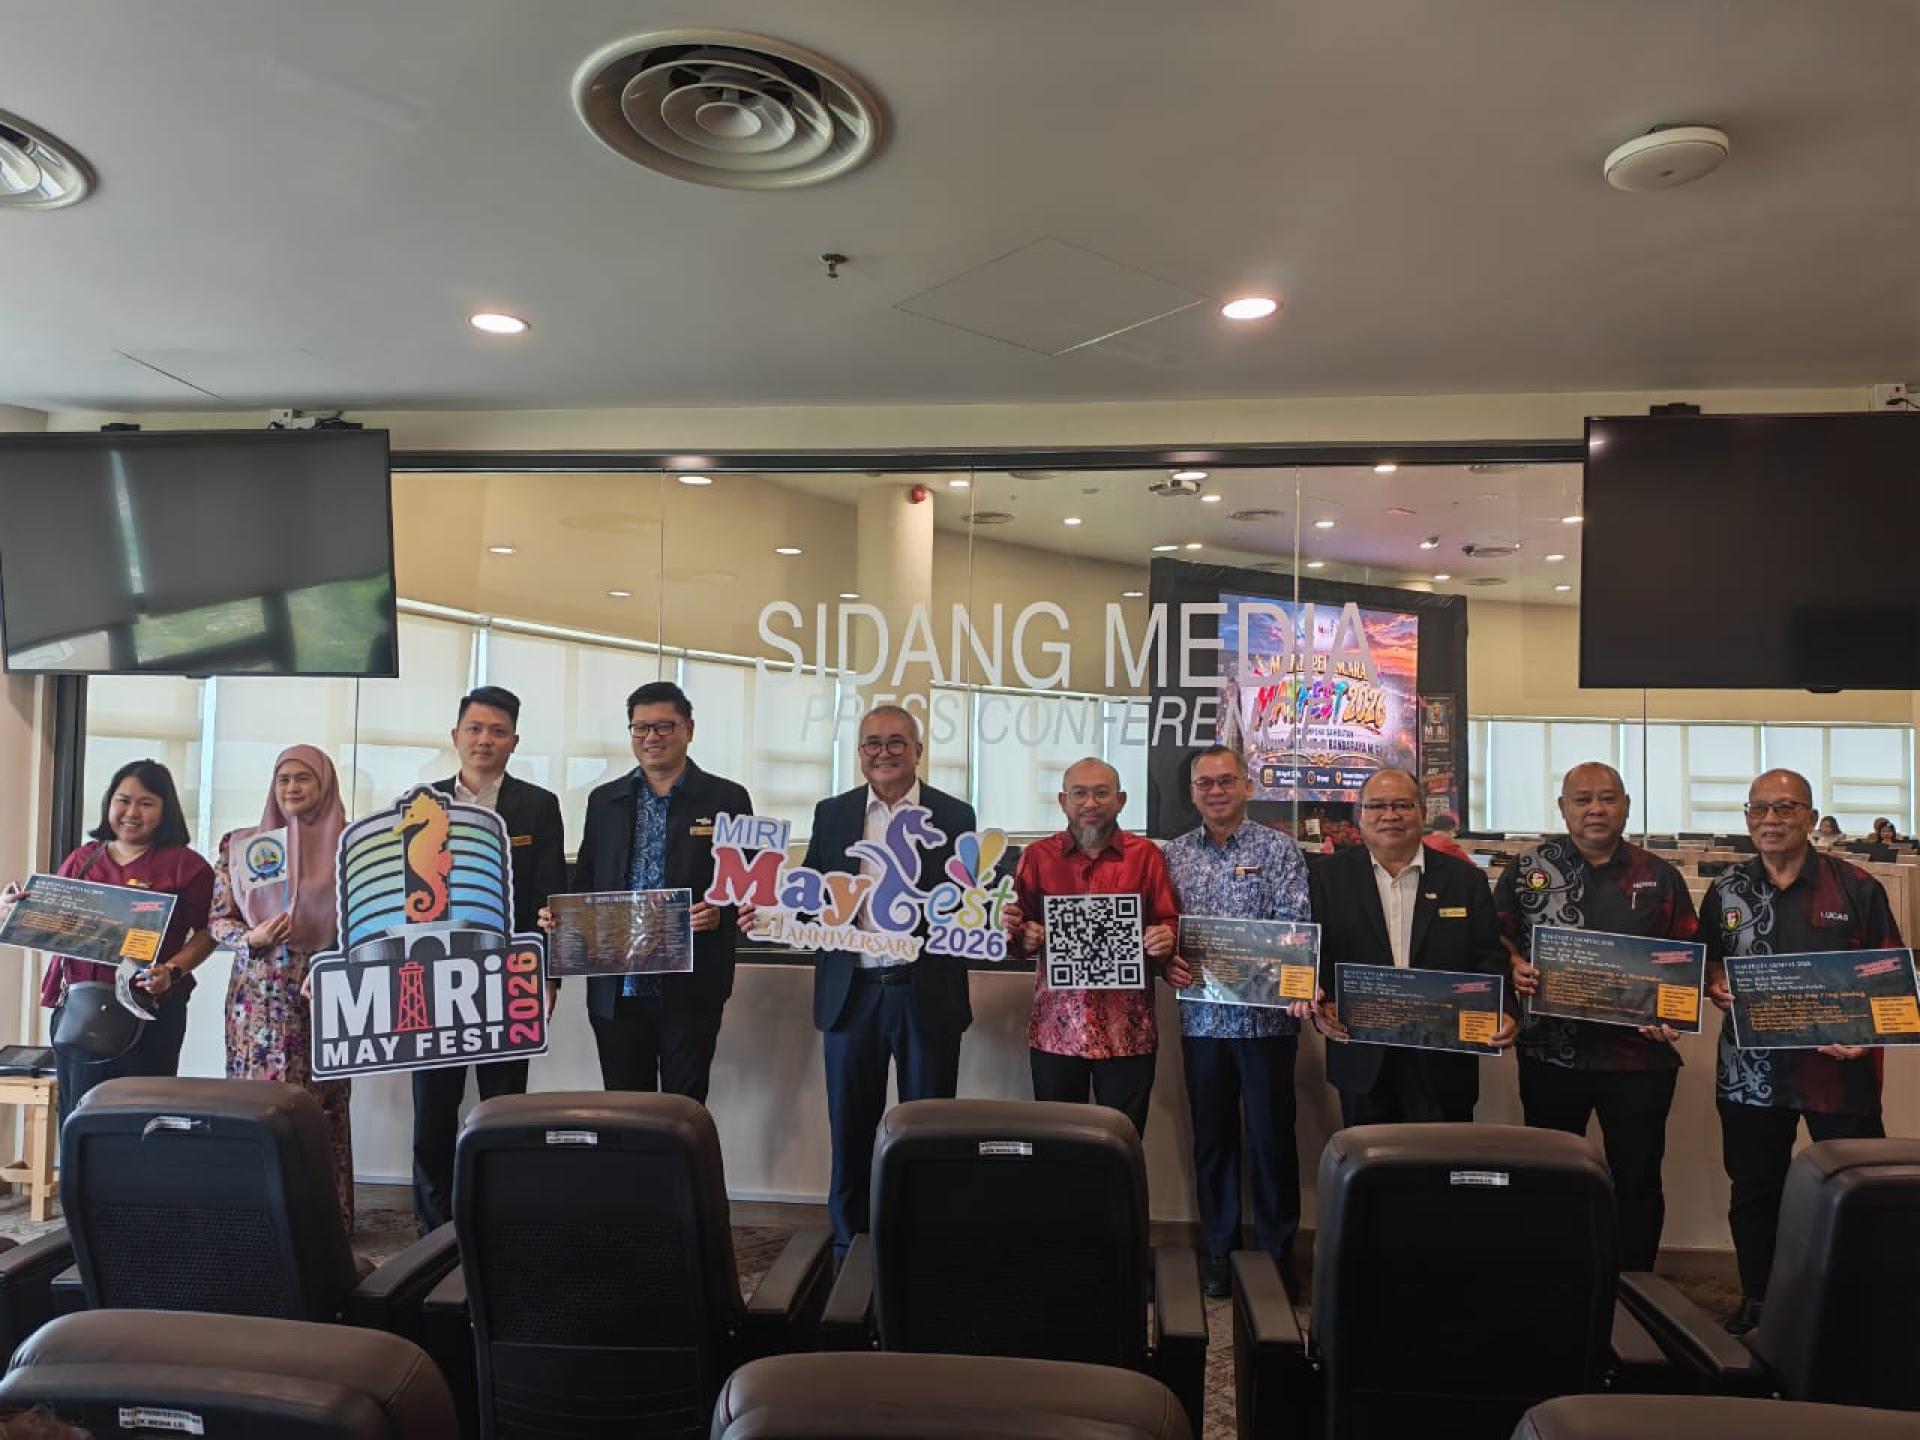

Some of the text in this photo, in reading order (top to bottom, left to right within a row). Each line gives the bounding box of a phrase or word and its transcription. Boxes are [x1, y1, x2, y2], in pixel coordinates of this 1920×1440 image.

[756, 601, 1379, 690] SIDANG MEDIA
[716, 815, 790, 849] MIRI
[788, 924, 922, 960] ANNIVERSARY
[929, 926, 1004, 957] 2026
[505, 950, 541, 1044] 2026
[322, 1026, 505, 1067] MAY FEST
